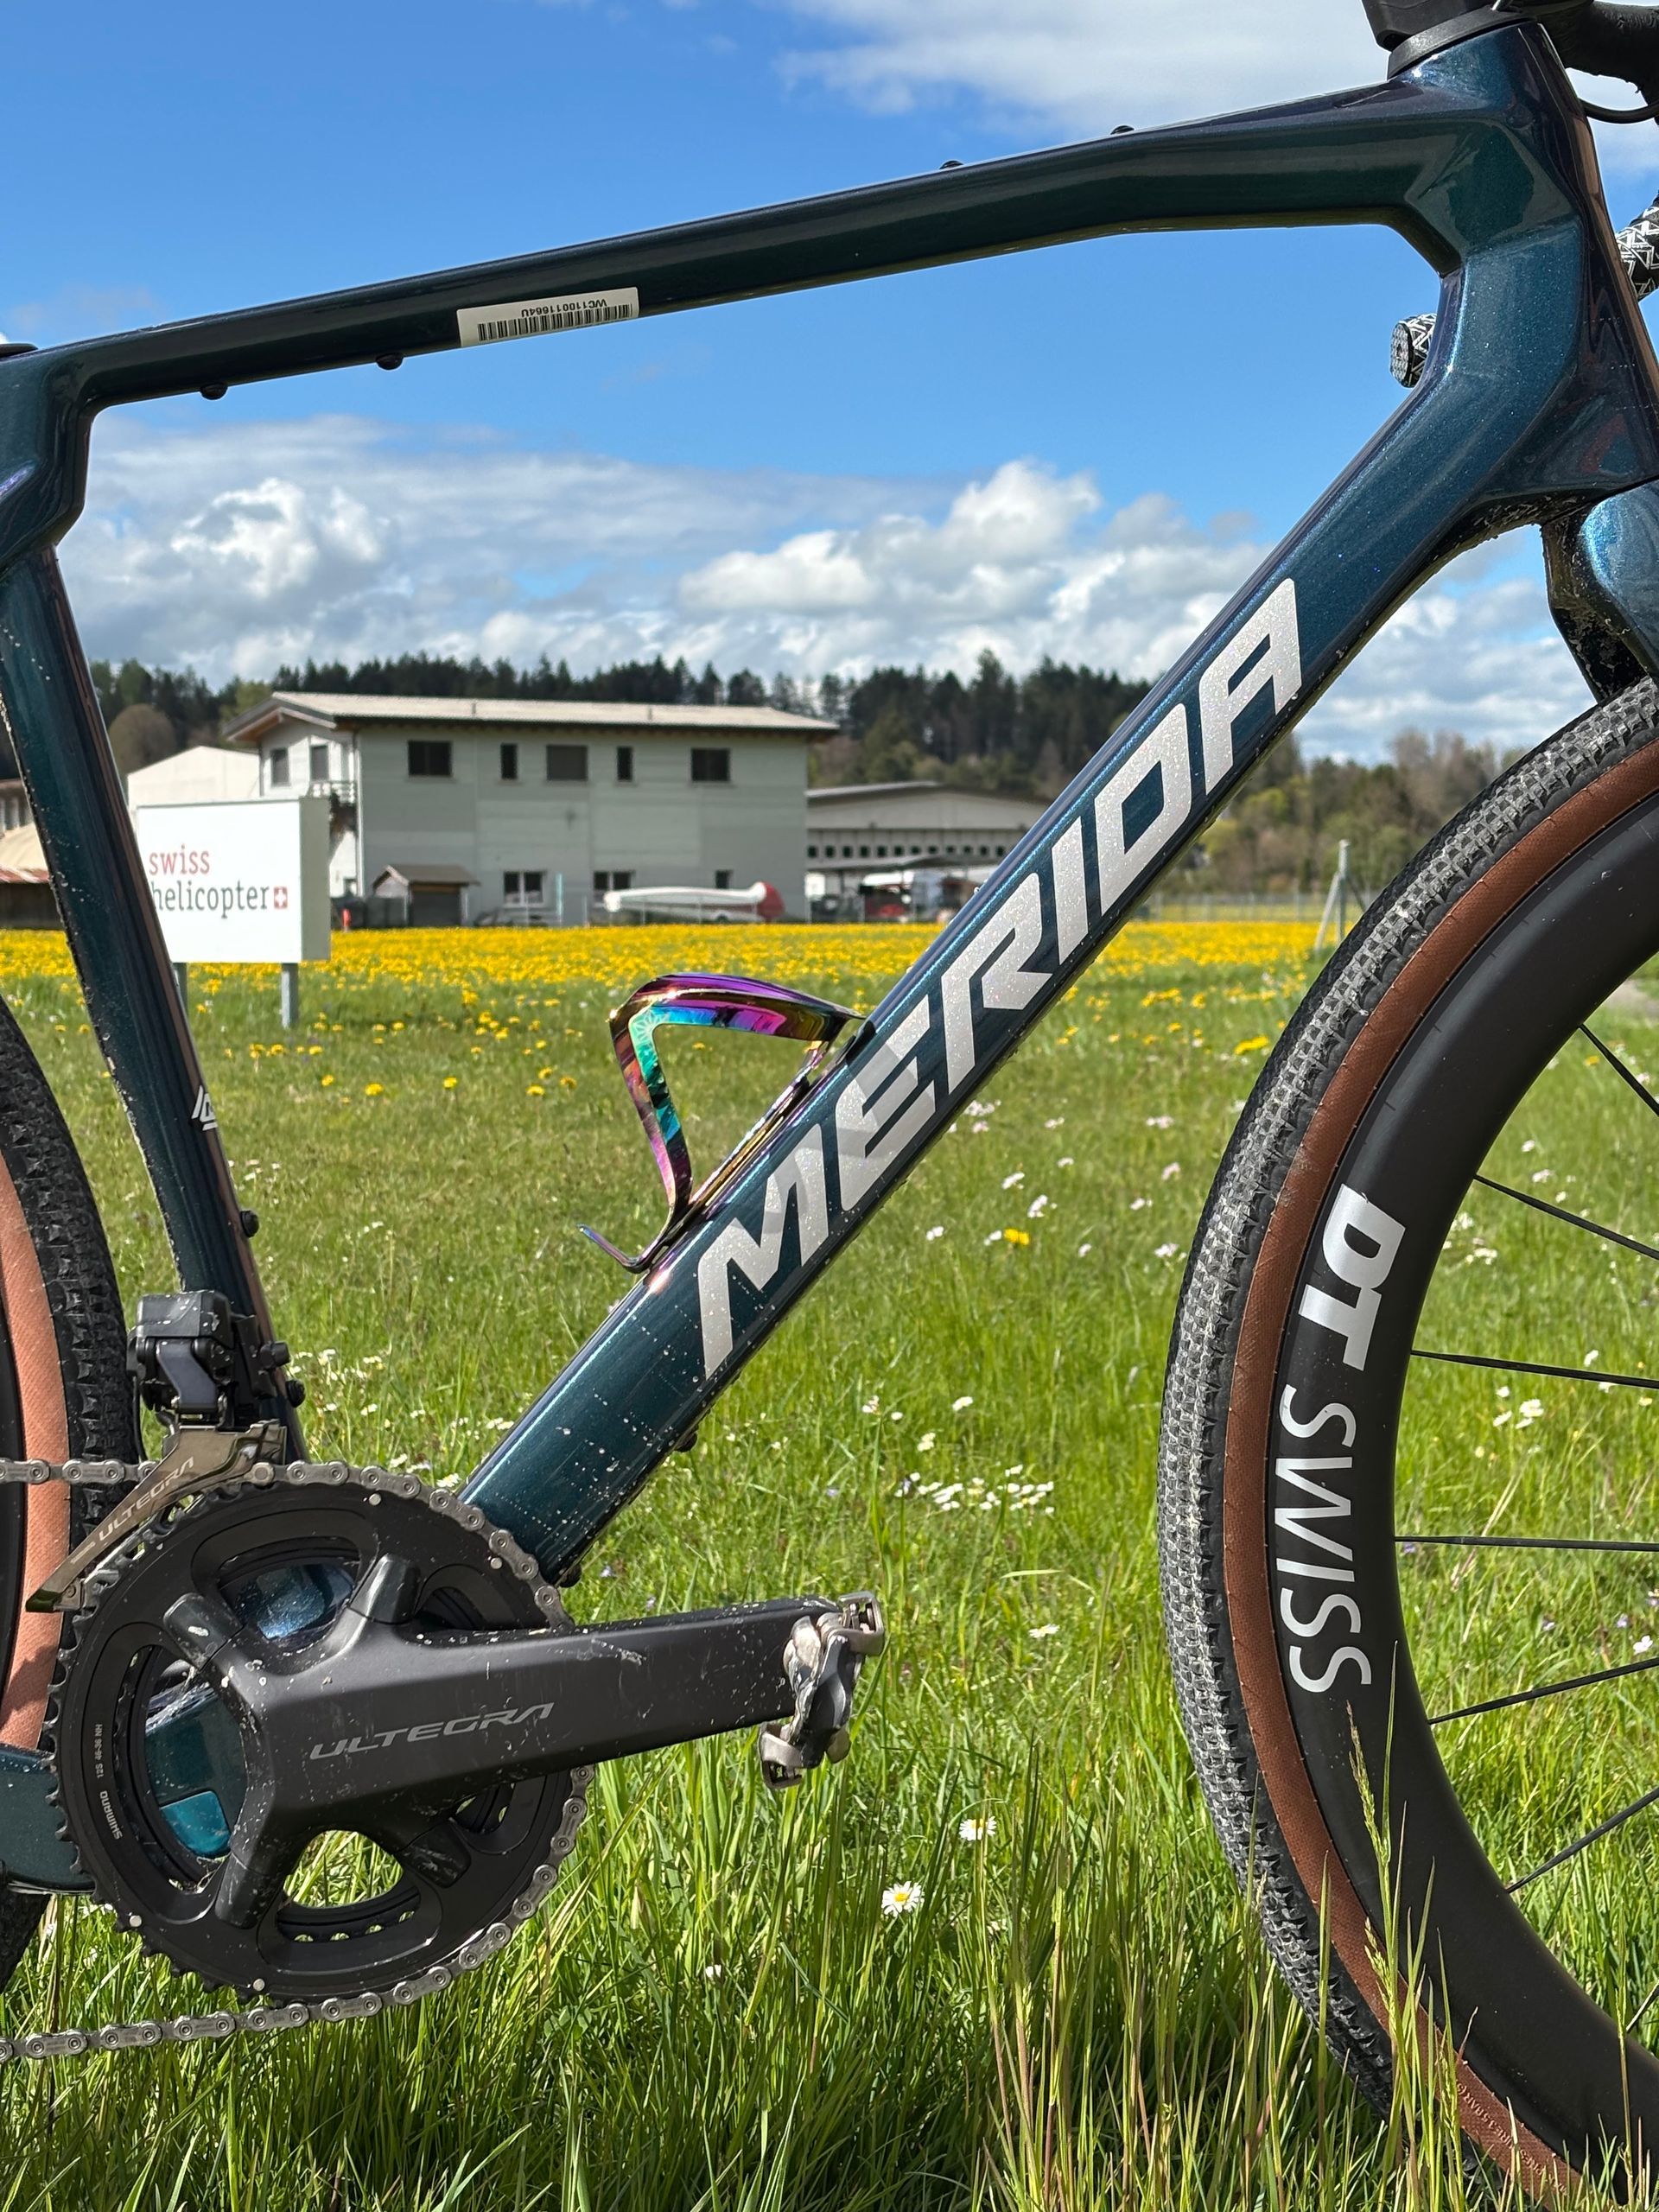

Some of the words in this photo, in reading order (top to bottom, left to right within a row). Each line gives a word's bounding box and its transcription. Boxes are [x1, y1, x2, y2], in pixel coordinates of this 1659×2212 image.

[521, 298, 608, 318] WC110011664U
[149, 843, 211, 876] swiss
[151, 880, 270, 920] helicopter
[698, 577, 1302, 1382] MERIDA
[1298, 1183, 1407, 1372] DT
[99, 1456, 194, 1541] ULTEGRA
[1274, 1383, 1373, 1694] SWISS
[309, 1701, 555, 1761] ULTEGRA
[99, 1790, 124, 1840] SHIMANO
